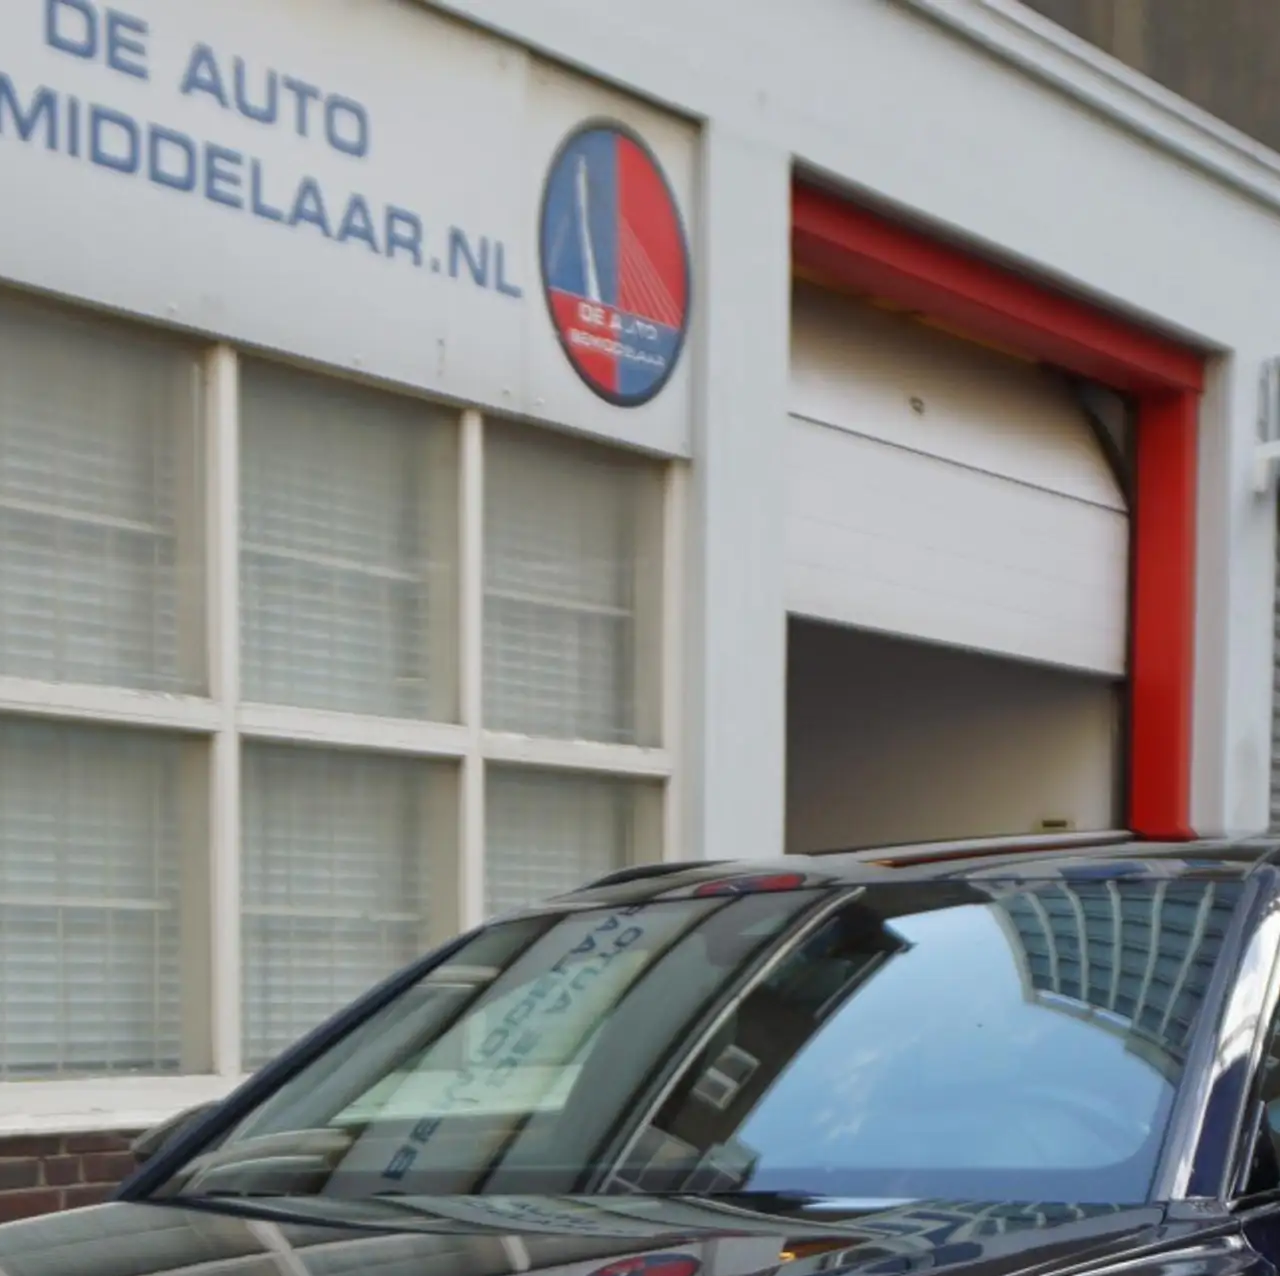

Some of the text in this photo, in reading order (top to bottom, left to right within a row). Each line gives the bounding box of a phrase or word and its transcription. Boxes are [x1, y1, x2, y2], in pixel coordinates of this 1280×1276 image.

[45, 0, 370, 159] DE AUTO
[578, 301, 605, 327] DE
